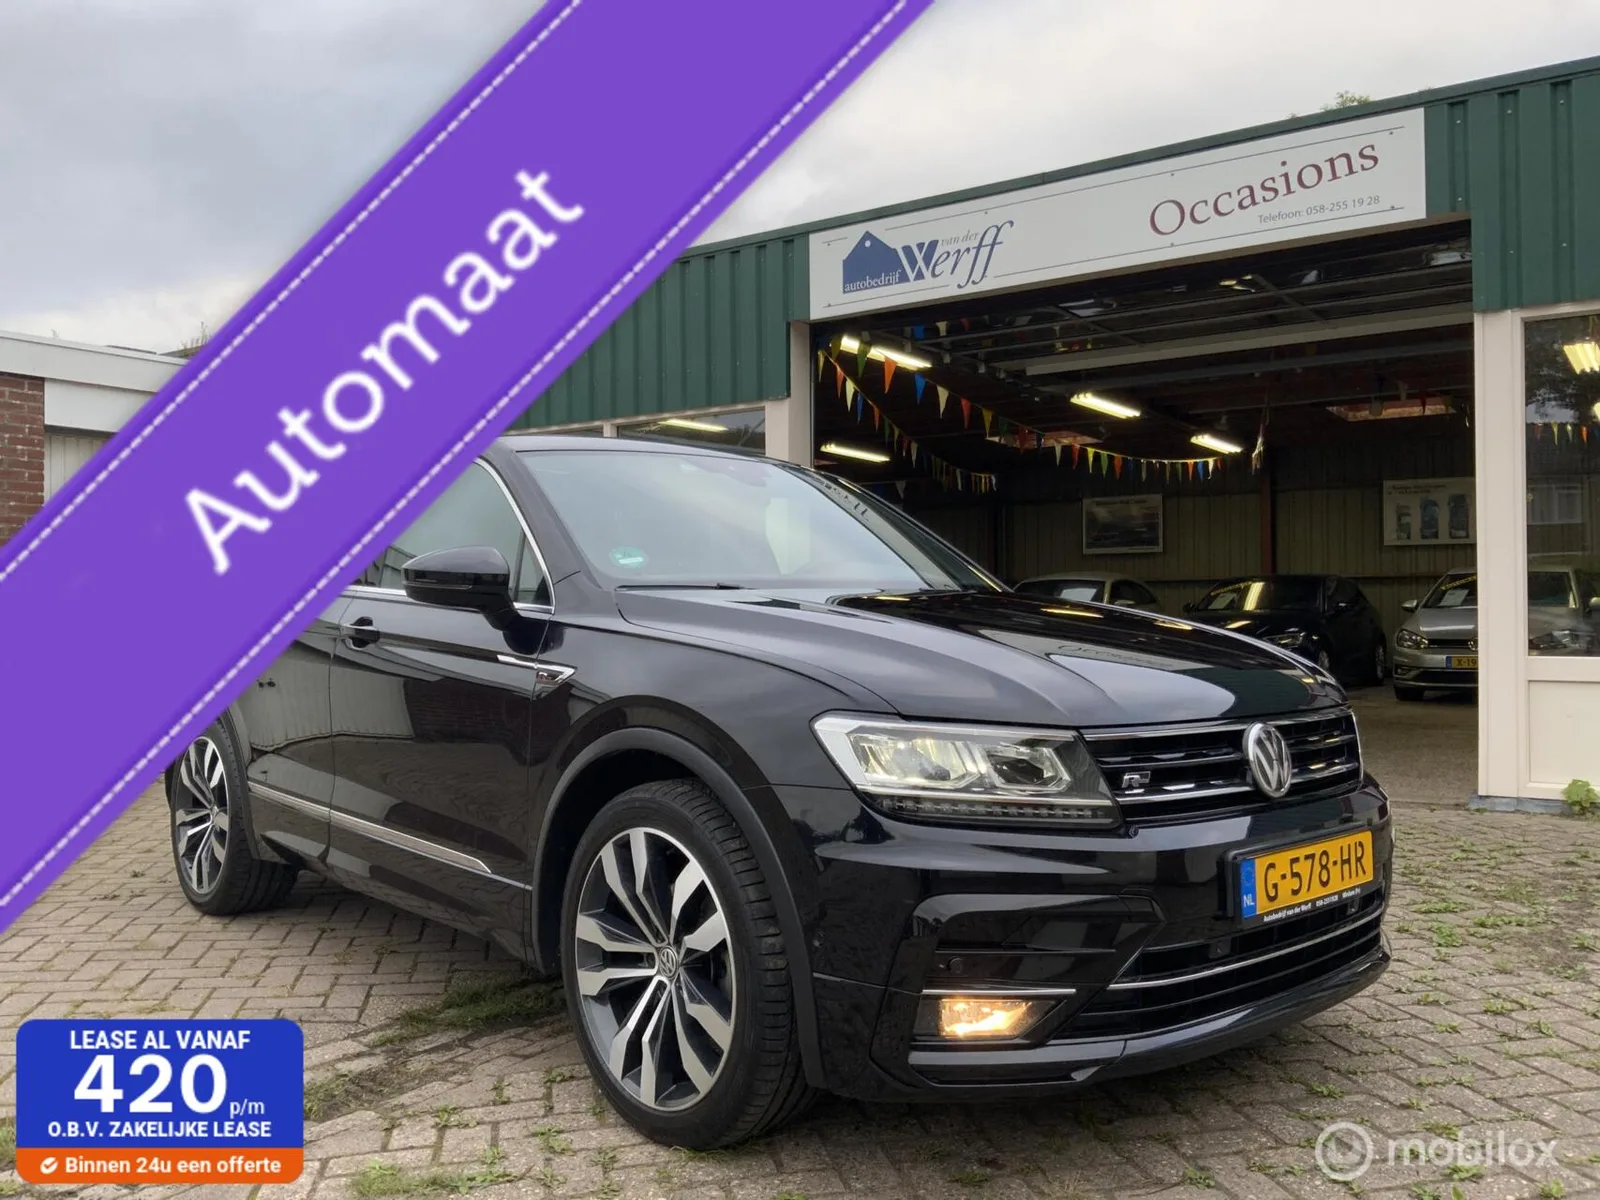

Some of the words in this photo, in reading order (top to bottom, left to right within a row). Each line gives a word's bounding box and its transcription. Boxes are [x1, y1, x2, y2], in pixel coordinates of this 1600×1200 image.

[1149, 143, 1380, 236] Occasions
[1258, 208, 1304, 225] Telefoon:
[1305, 202, 1349, 217] 058-255
[1352, 196, 1364, 210] 19
[1366, 195, 1381, 207] 28
[940, 236, 961, 247] van
[962, 230, 980, 243] der
[897, 220, 1014, 289] Werff
[844, 270, 902, 292] autobedrijf
[1264, 840, 1367, 903] G-578-HR
[1242, 893, 1255, 908] NL
